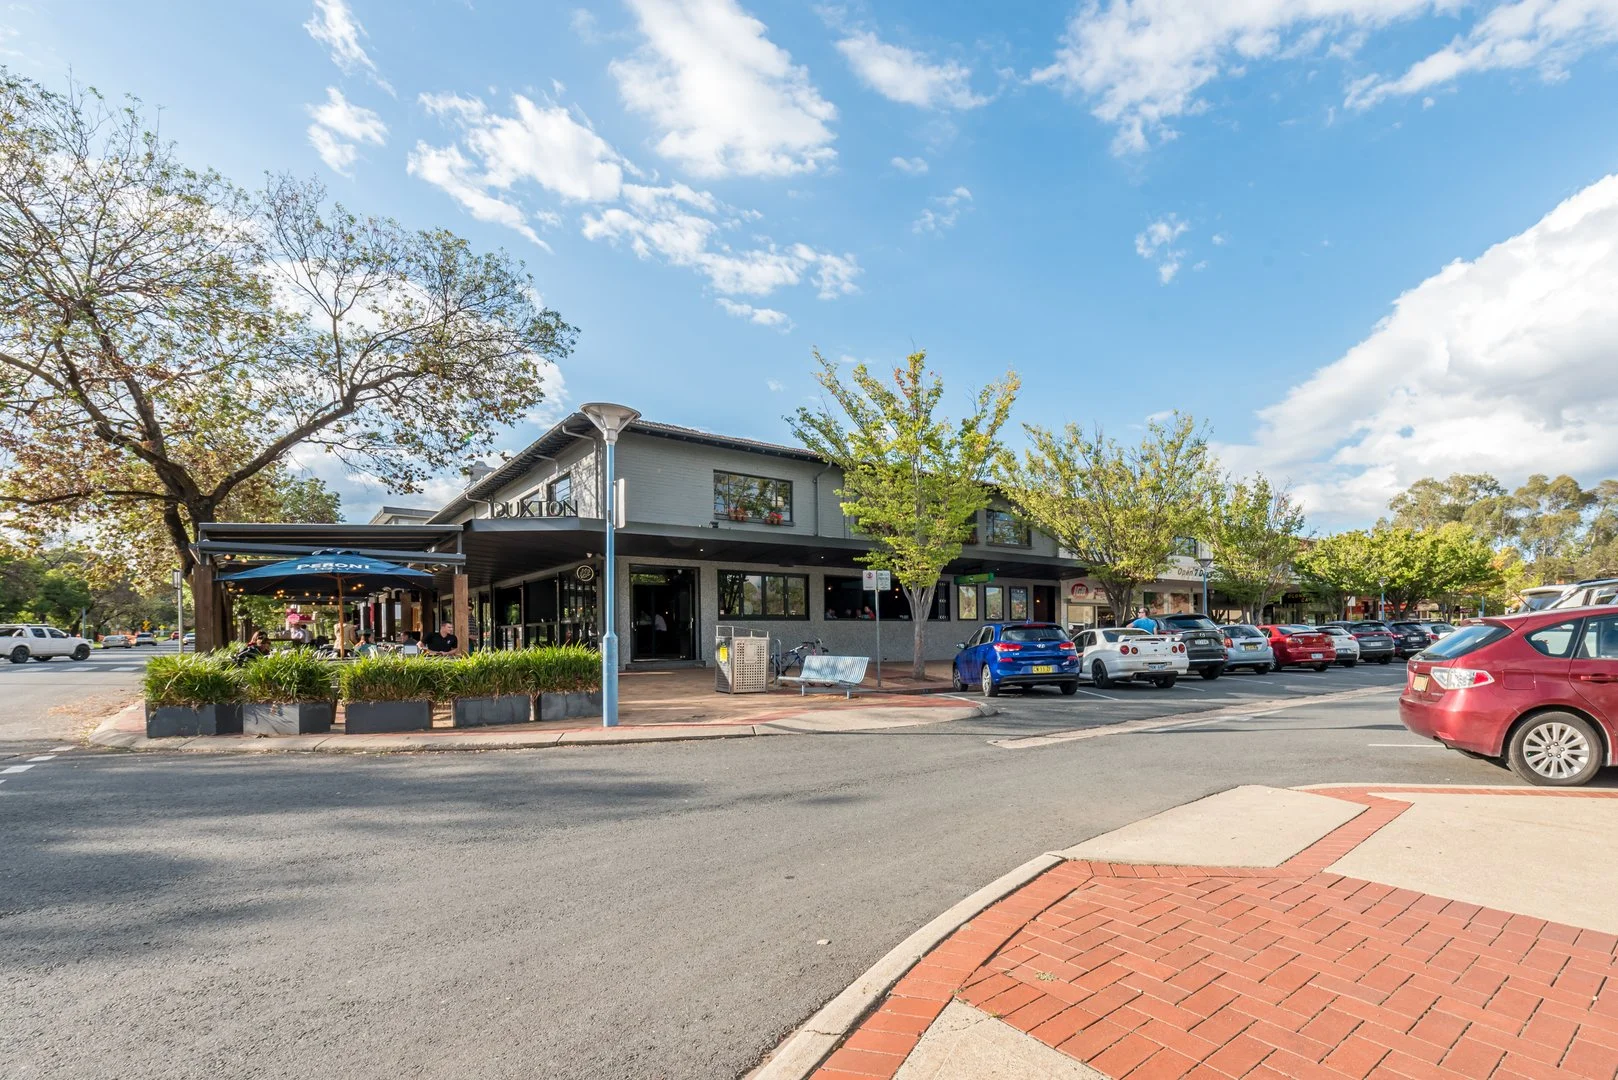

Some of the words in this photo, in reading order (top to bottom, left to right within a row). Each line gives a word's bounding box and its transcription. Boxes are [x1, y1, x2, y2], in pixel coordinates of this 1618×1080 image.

[490, 500, 578, 517] DUXTON
[297, 562, 370, 570] PERONI
[1178, 568, 1193, 576] Open
